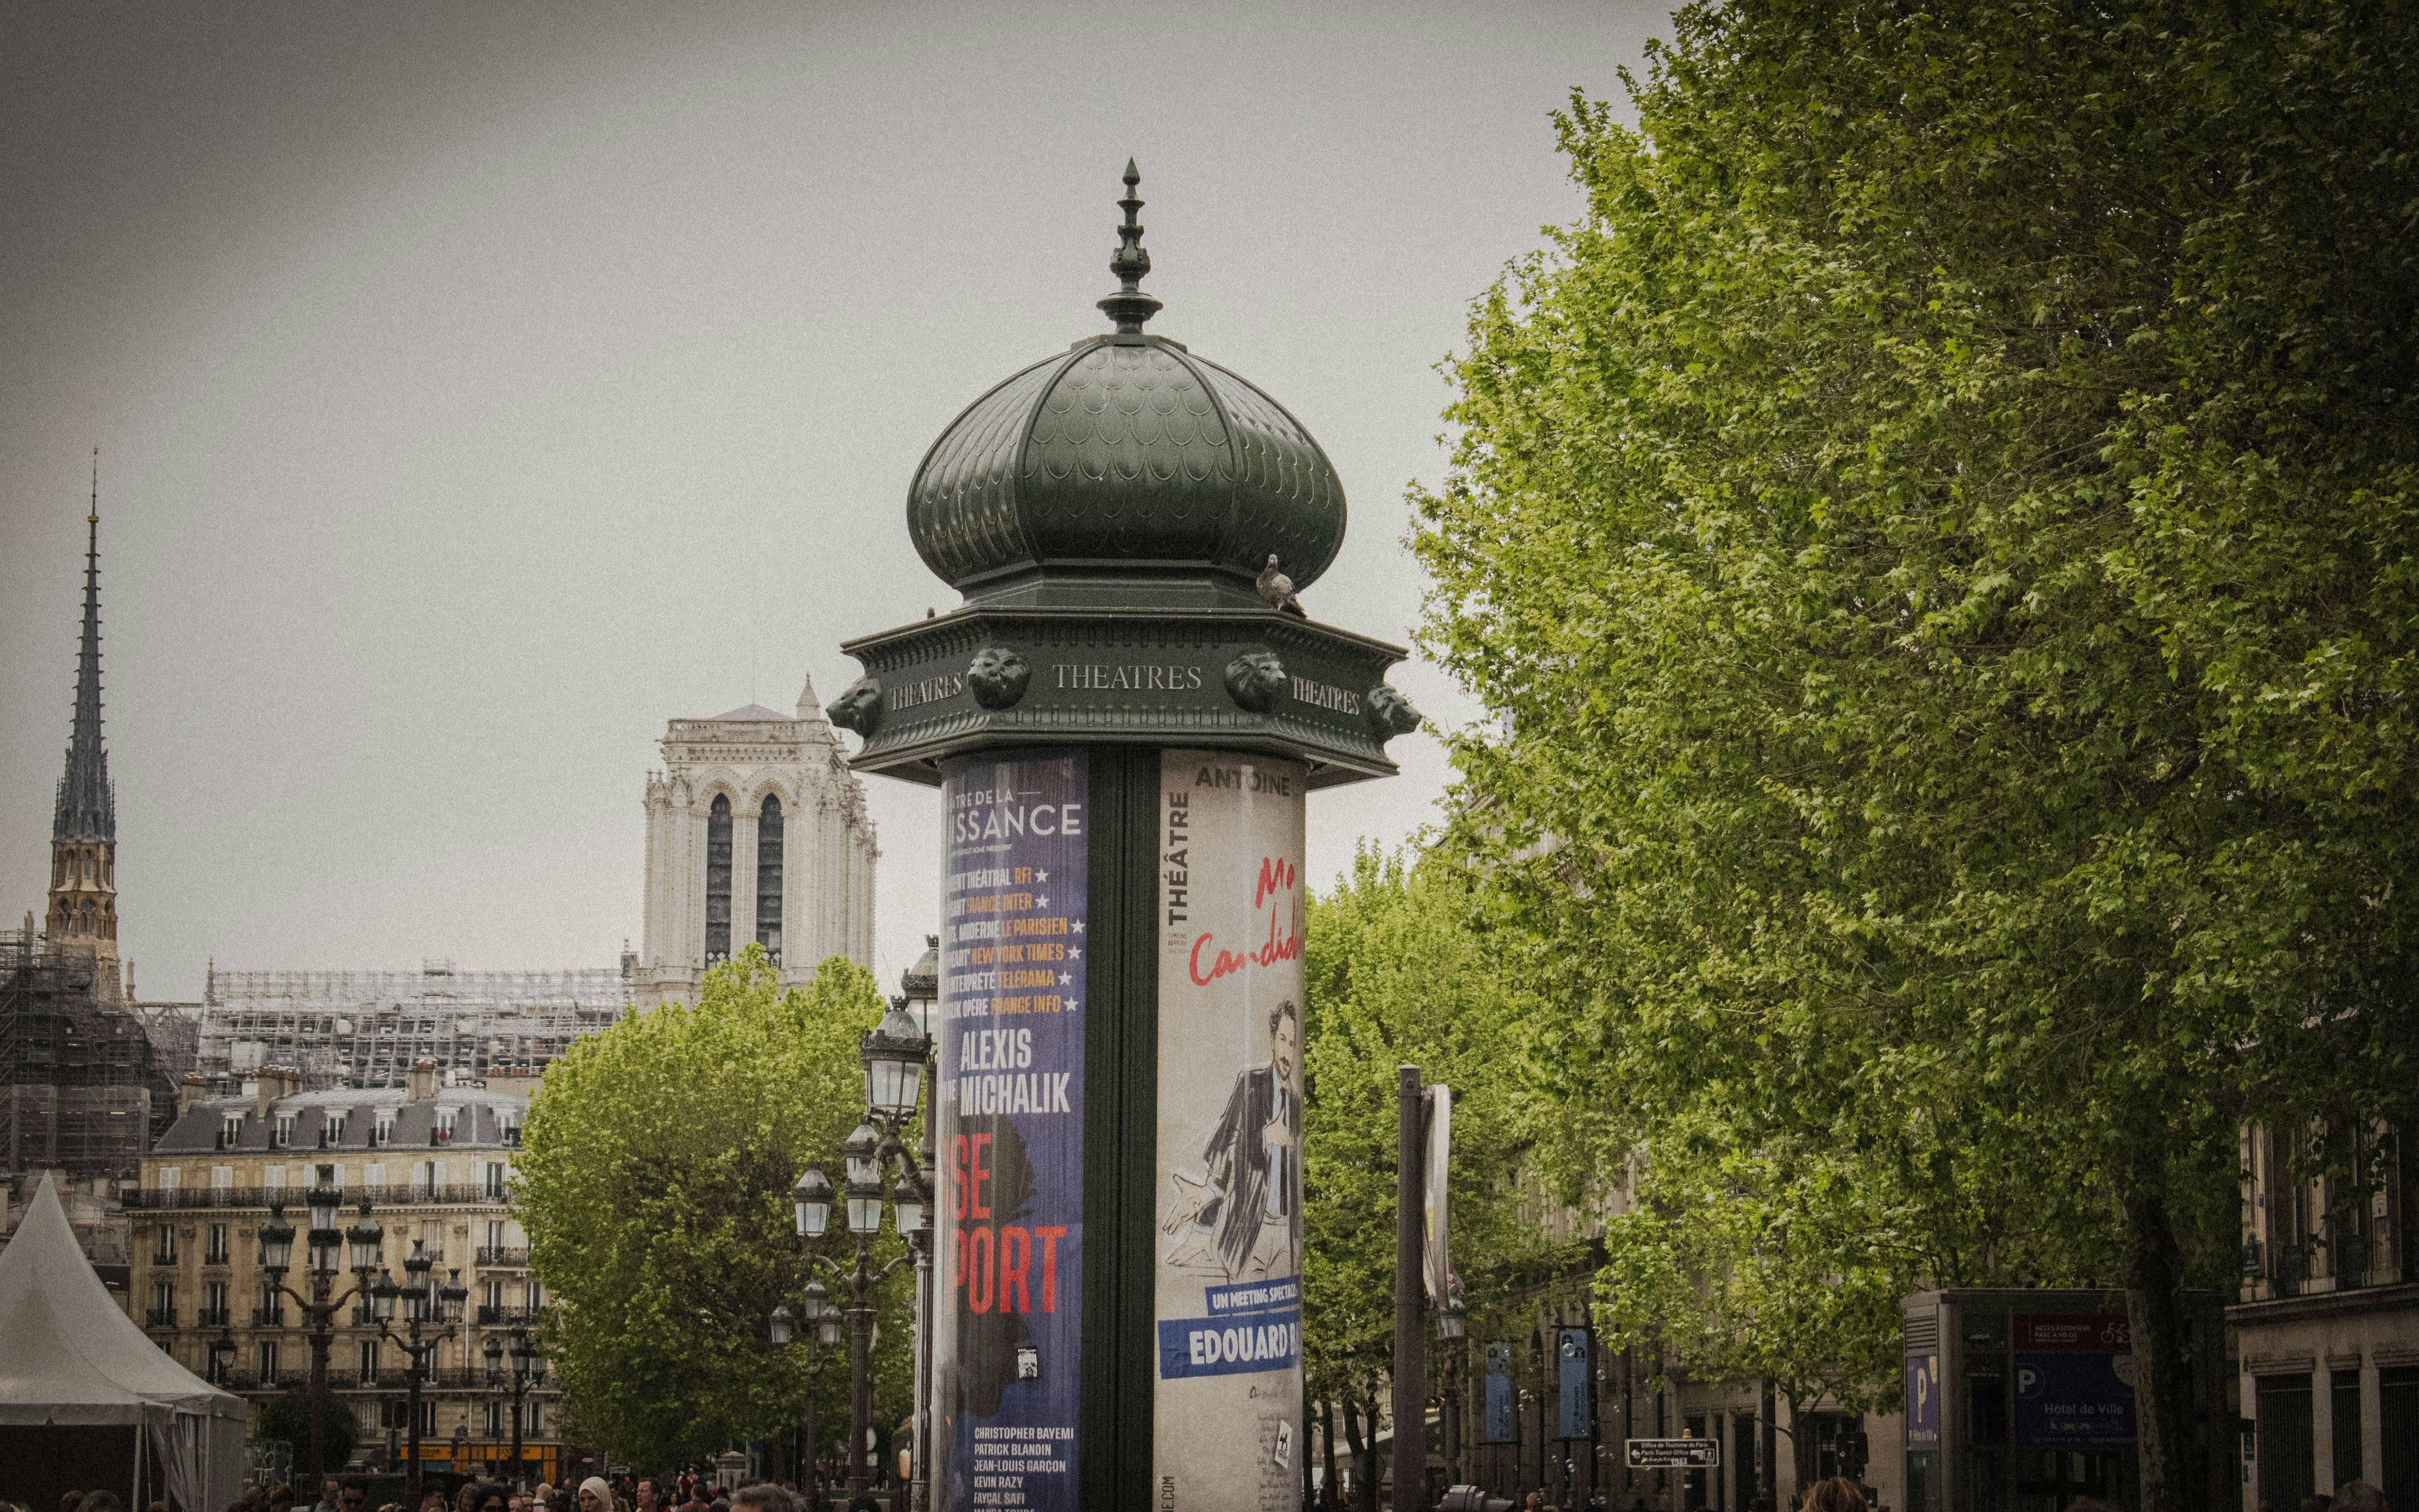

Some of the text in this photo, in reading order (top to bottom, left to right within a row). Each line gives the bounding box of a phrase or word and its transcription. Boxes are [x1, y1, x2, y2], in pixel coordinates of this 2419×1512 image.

[1052, 664, 1202, 690] THEATRES
[891, 672, 962, 711] THEATRES
[1291, 676, 1360, 716] THEATRES
[1195, 766, 1290, 797] ANTOINE
[975, 790, 993, 806] DE
[996, 788, 1014, 803] LA
[1163, 792, 1188, 926] THÉÂTRE
[1014, 866, 1032, 884] RFI
[1003, 892, 1032, 912] INTER
[959, 920, 999, 941] MODERNE
[1001, 920, 1012, 937] LE
[1014, 918, 1067, 936] PARISIEN
[971, 947, 994, 965] NEW
[996, 944, 1024, 963] YORK
[1027, 943, 1064, 961] TIMES
[991, 996, 1031, 1015] FRANCE
[1034, 995, 1061, 1013] INFO
[960, 1028, 1031, 1072] ALEXIS
[960, 1072, 1071, 1116] MICHALIK
[1212, 1292, 1229, 1310] UN
[1230, 1288, 1269, 1307] MEETING
[1189, 1323, 1288, 1366] EDOUARD
[2018, 1369, 2036, 1393] P
[1918, 1368, 1927, 1423] P
[2079, 1404, 2095, 1415] de
[2098, 1404, 2124, 1415] Ville
[975, 1427, 1074, 1440] CHRISTOPHER BAYEMI
[975, 1444, 1051, 1456] PATRICK BLANDIN
[974, 1460, 1066, 1474] JEAN-LOUIS GARÇON
[999, 1476, 1023, 1488] RAZY
[1004, 1493, 1025, 1504] SAFI
[1161, 1476, 1175, 1512] E.COM
